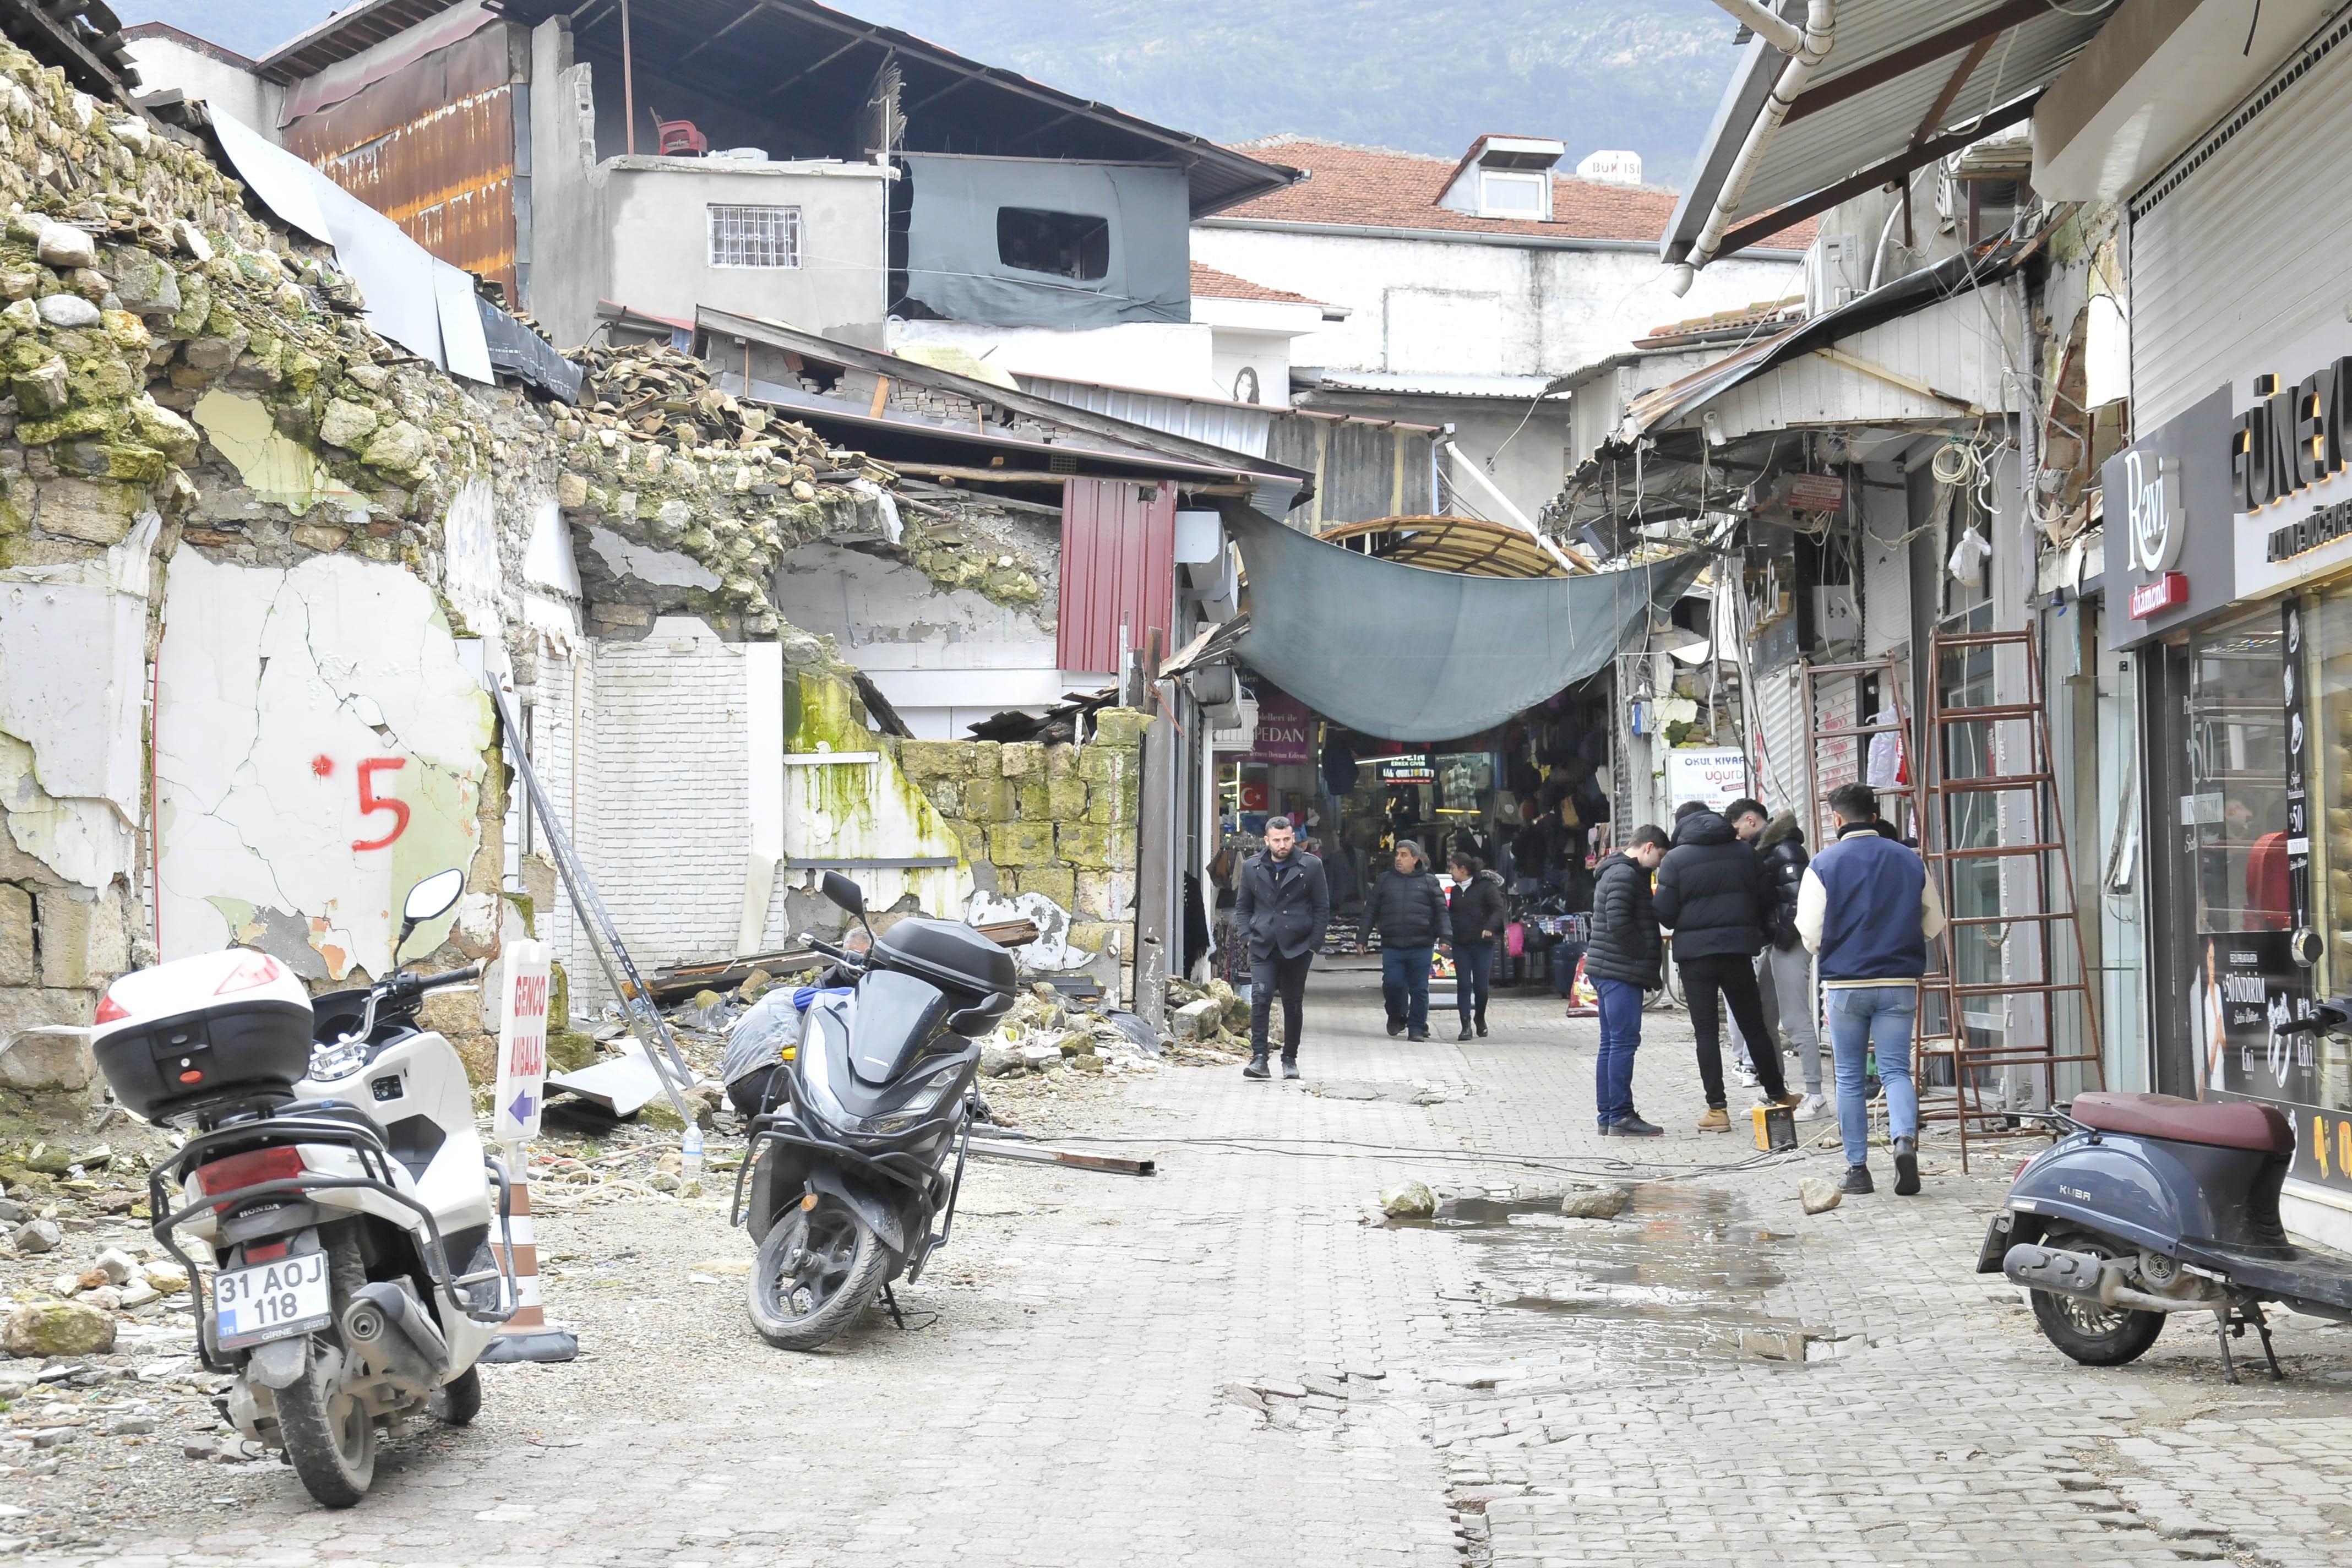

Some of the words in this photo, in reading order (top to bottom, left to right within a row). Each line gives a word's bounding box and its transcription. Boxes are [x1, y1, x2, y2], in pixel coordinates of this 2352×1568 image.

[2125, 450, 2170, 571] Ravi
[2133, 573, 2166, 616] diamond
[1685, 758, 1712, 766] OKUL
[352, 757, 411, 852] 5
[515, 975, 546, 1017] GENCO
[2234, 971, 2266, 1003] İNDİRİM
[510, 1036, 543, 1078] AMBALAJ
[239, 1203, 281, 1218] HONDA
[2060, 1184, 2091, 1201] KUBA
[220, 1273, 249, 1303] 31
[263, 1256, 322, 1294] AOJ
[254, 1292, 298, 1324] 118
[222, 1325, 235, 1335] TR
